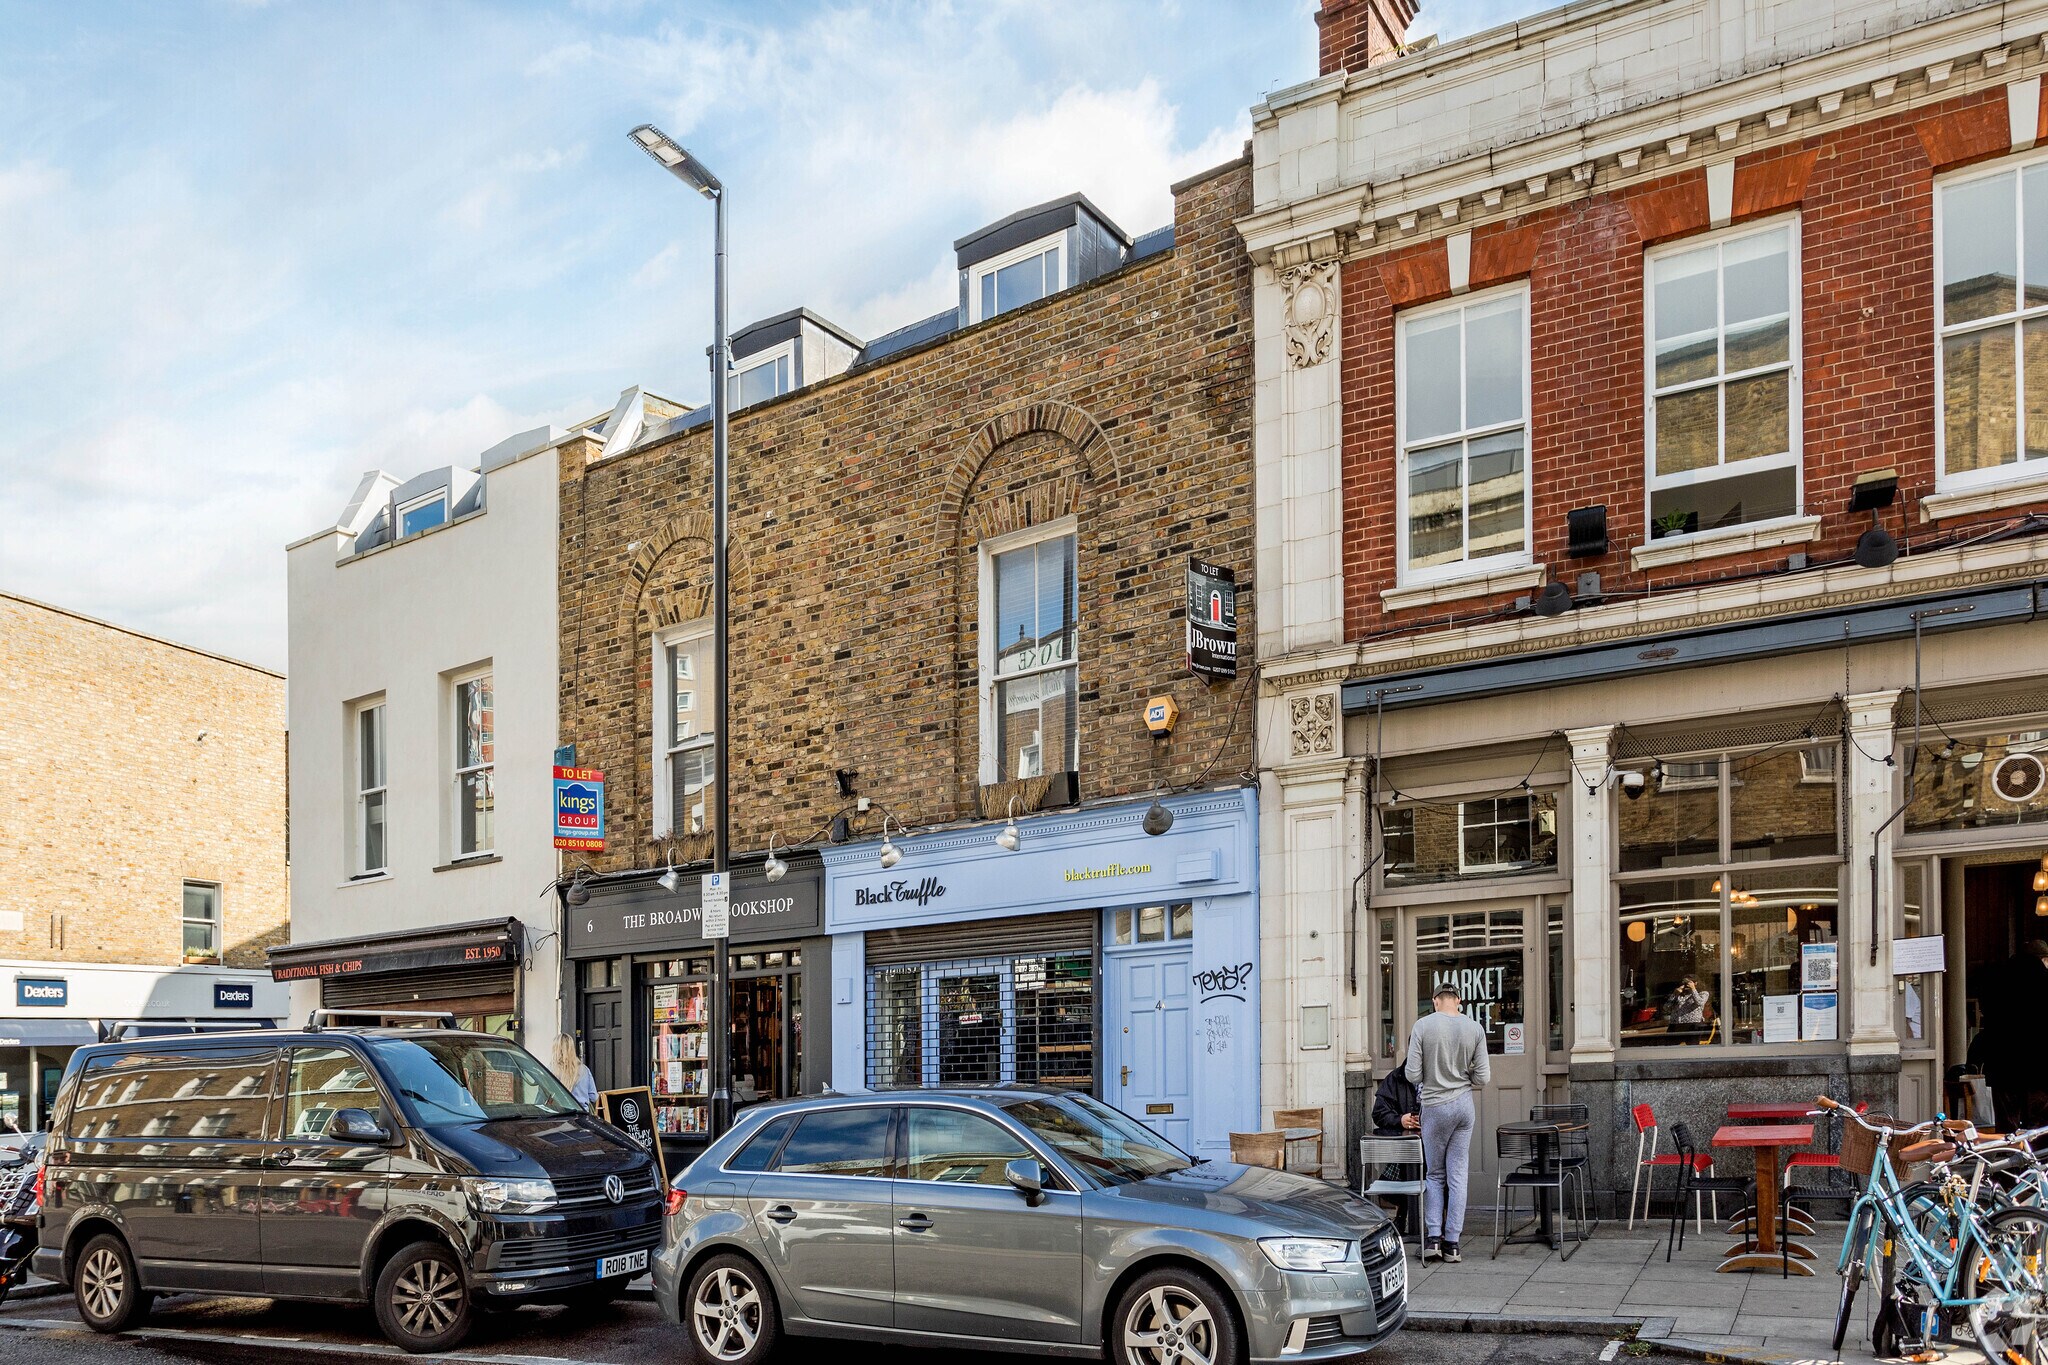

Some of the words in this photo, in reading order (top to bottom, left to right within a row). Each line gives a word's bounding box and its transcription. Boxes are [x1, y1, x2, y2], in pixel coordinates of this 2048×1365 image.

[1201, 564, 1209, 574] TO
[1210, 567, 1219, 576] LET
[562, 768, 574, 779] TO
[576, 769, 593, 780] LET
[560, 791, 595, 814] kings
[560, 815, 596, 826] GROUP
[557, 828, 599, 837] kings-group.net
[555, 838, 567, 847] 020
[568, 839, 585, 848] 8510
[585, 840, 603, 849] 0808
[1064, 863, 1151, 882] blacktruffle.com
[855, 884, 893, 906] Black
[890, 876, 946, 907] Truffle
[623, 914, 646, 929] THE
[729, 898, 794, 917] OOKSHOP
[587, 919, 593, 933] 6
[465, 947, 481, 960] EST.
[483, 945, 501, 958] 1950
[274, 965, 318, 980] TRADITIONAL
[319, 963, 334, 975] FISH
[335, 962, 341, 973] &
[341, 960, 362, 972] CHIPS
[1434, 967, 1505, 1001] MARKET
[24, 985, 64, 998] Dexters
[220, 990, 250, 1001] Dexters
[1457, 1002, 1496, 1034] AFE
[627, 1124, 640, 1133] THE
[606, 1257, 627, 1275] RO18
[629, 1252, 645, 1269] TNE
